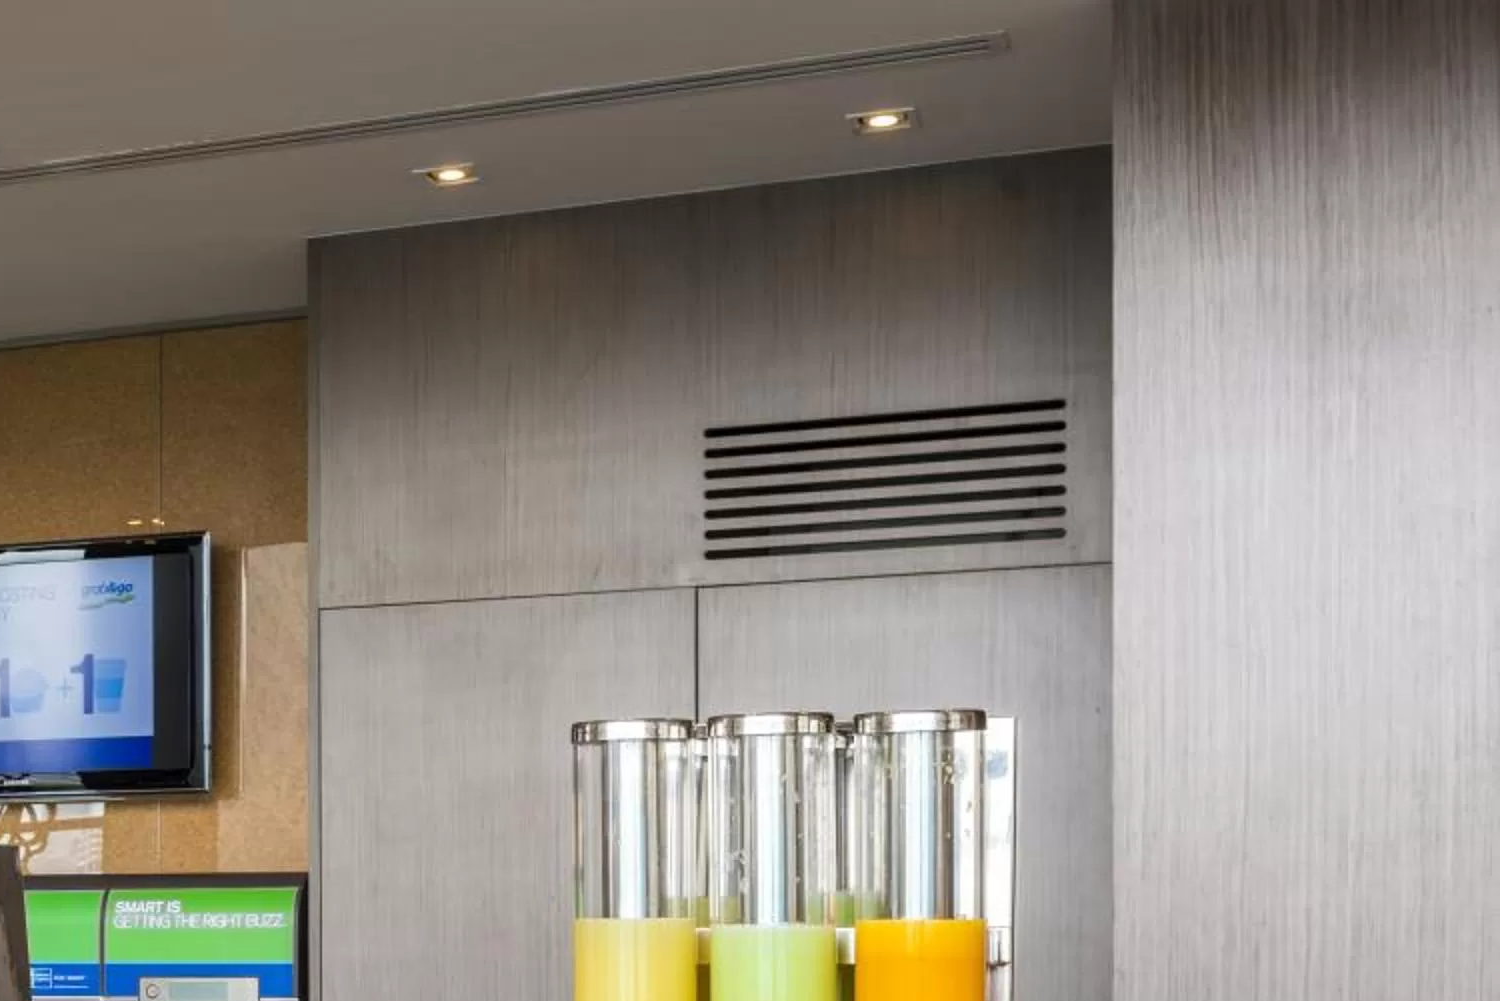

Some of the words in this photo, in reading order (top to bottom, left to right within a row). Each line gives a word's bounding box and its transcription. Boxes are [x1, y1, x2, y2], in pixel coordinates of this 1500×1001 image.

[70, 653, 94, 715] 1
[115, 900, 164, 913] SMART
[167, 900, 181, 913] IS
[113, 912, 171, 929] GETTING
[175, 912, 201, 929] THE
[203, 912, 242, 929] RIGHT
